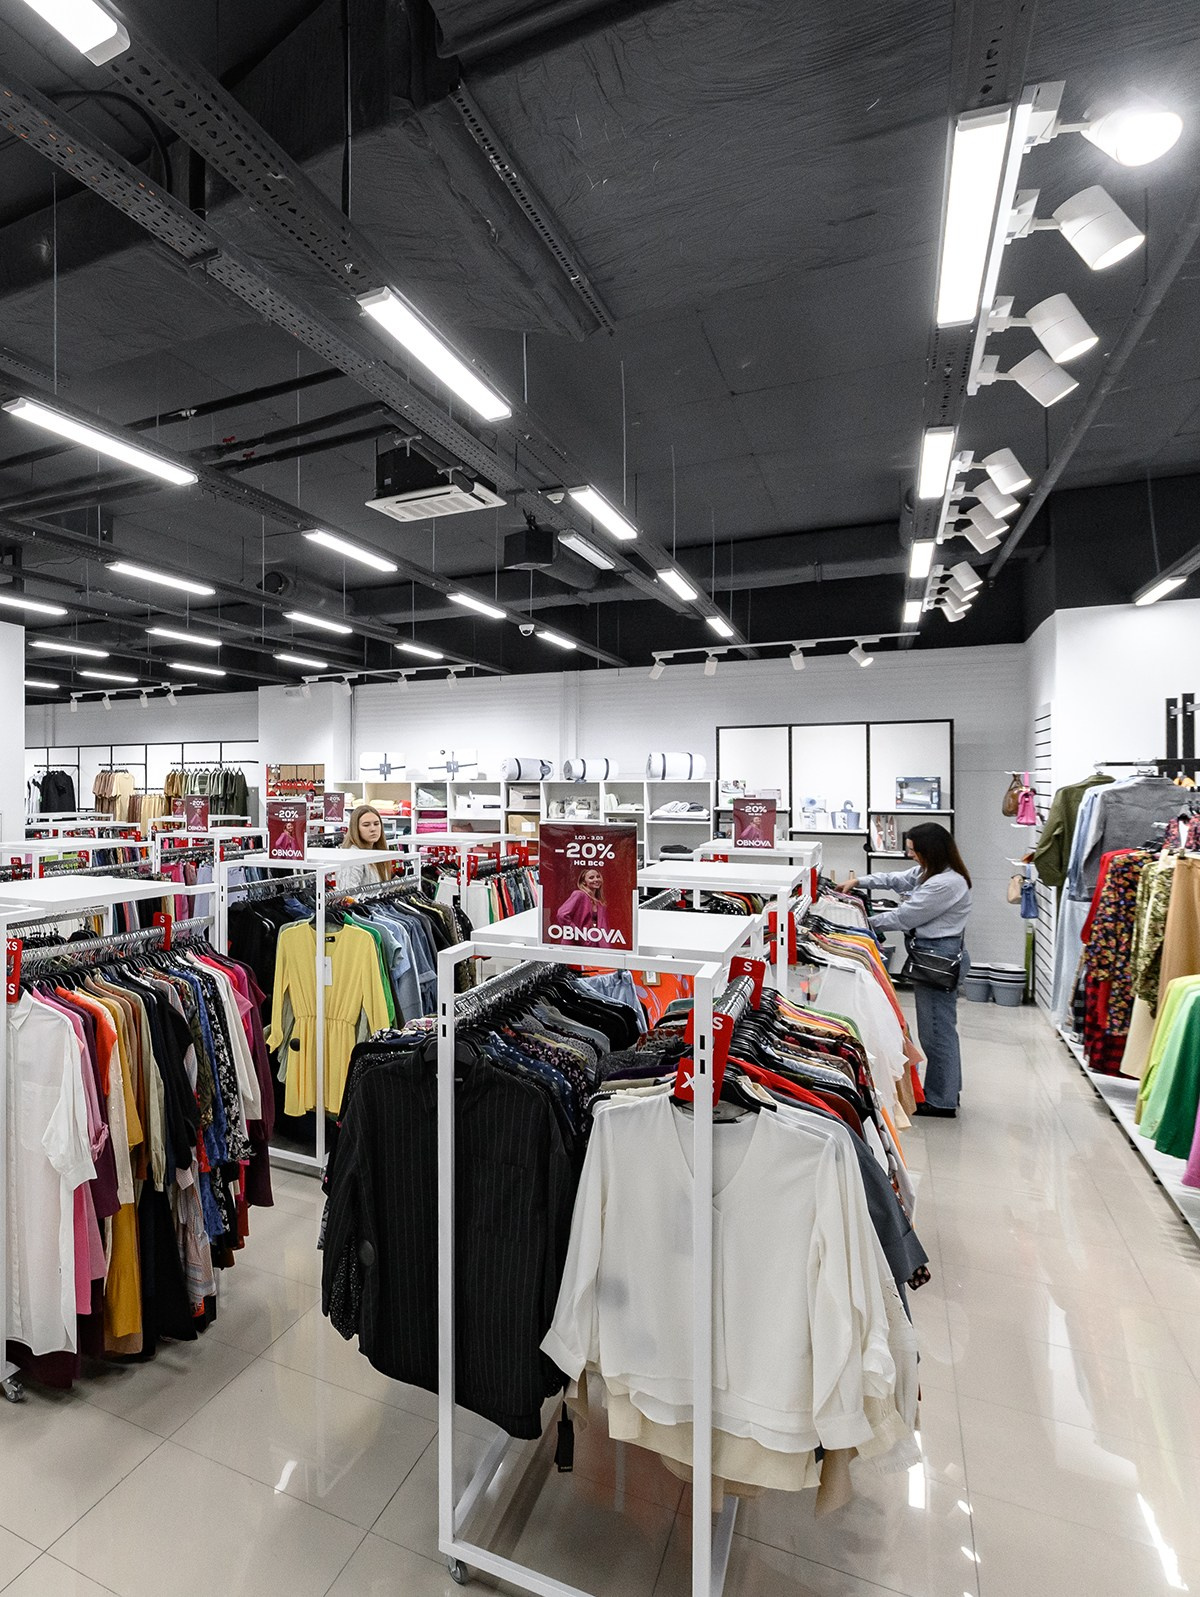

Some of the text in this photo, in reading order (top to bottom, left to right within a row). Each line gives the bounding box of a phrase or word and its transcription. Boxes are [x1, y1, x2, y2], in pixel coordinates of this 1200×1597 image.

[740, 805, 768, 813] -20%
[274, 810, 299, 819] -20%
[736, 839, 773, 847] OBNOVA
[271, 848, 303, 858] OBNOVA
[554, 842, 616, 860] -20%
[159, 915, 165, 923] S
[547, 924, 626, 945] OBNOVA
[743, 962, 753, 972] S
[712, 1016, 724, 1030] S
